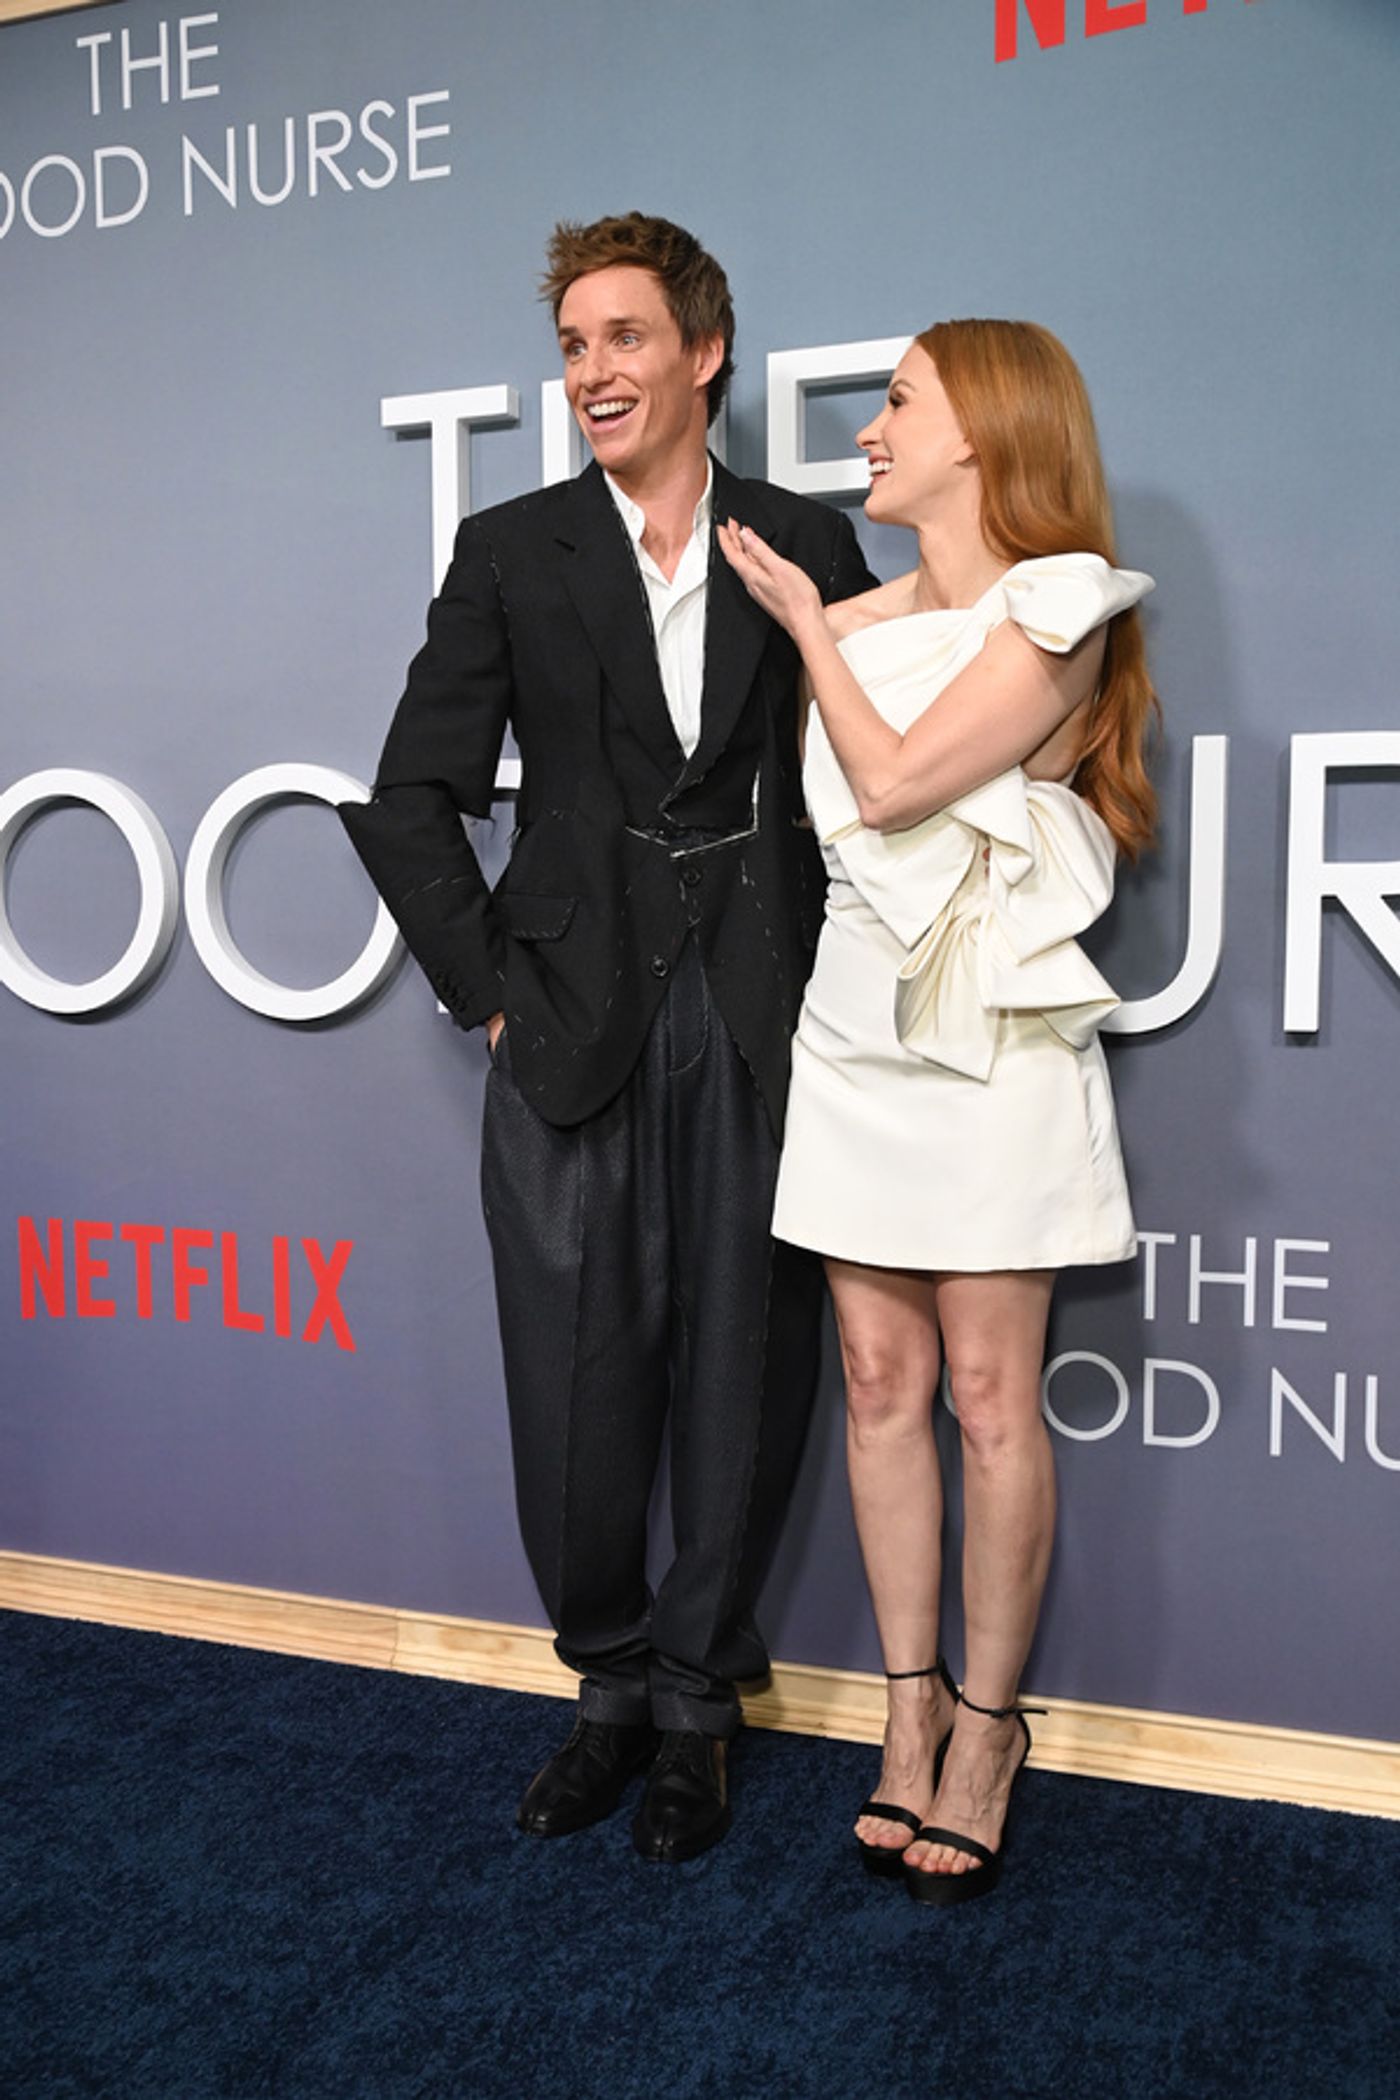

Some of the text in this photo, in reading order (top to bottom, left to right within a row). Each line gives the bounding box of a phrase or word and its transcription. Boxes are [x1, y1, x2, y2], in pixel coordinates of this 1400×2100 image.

[76, 12, 219, 115] THE
[0, 89, 451, 239] OD NURSE
[18, 1216, 356, 1353] NETFLIX
[1137, 1231, 1330, 1332] THE
